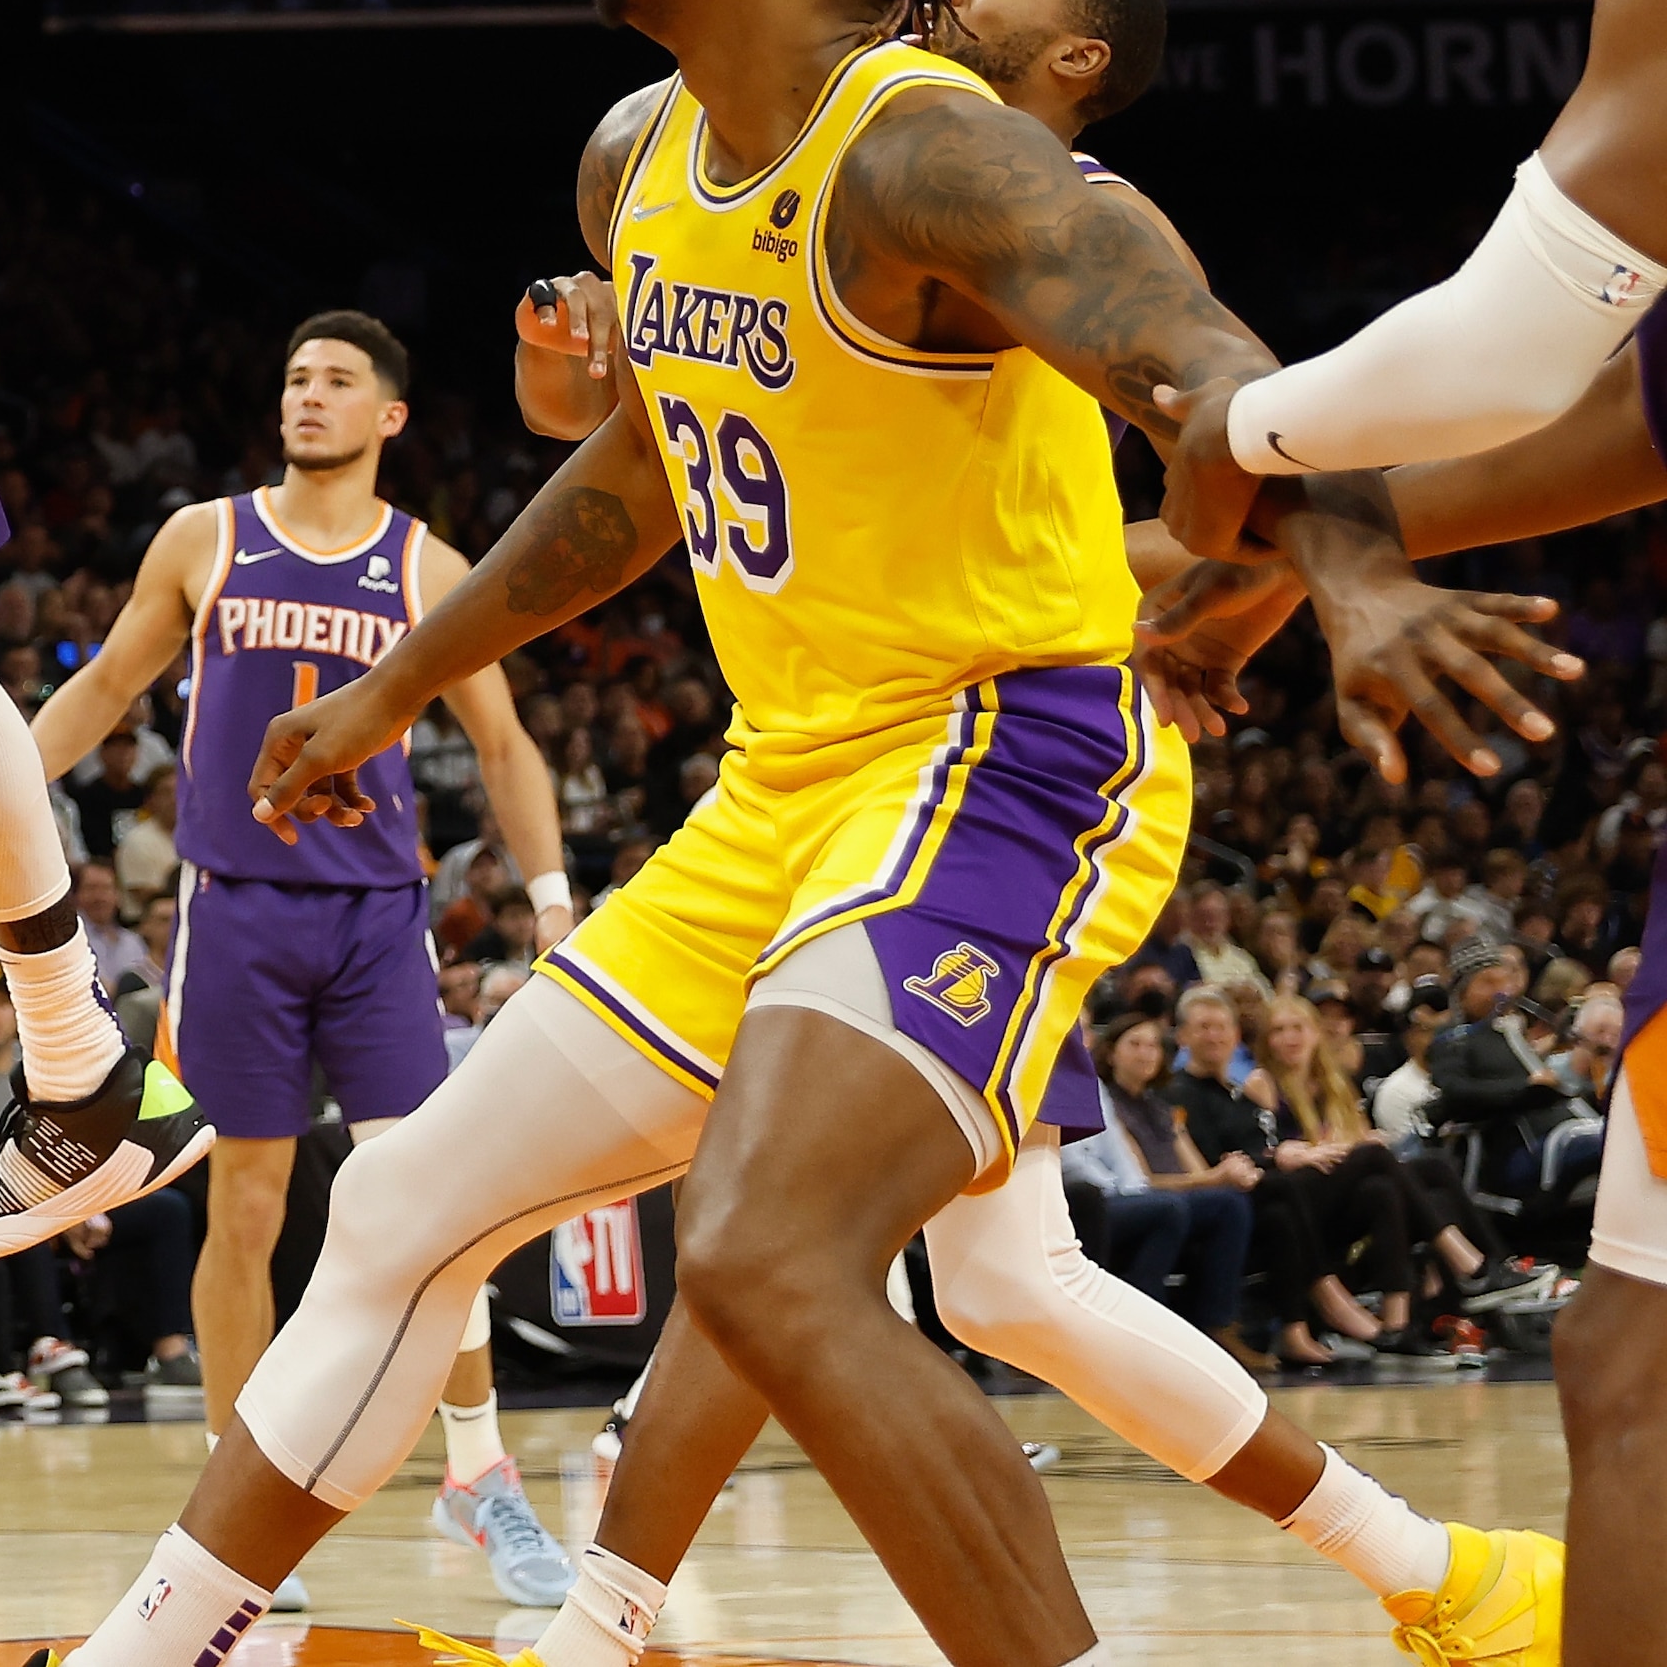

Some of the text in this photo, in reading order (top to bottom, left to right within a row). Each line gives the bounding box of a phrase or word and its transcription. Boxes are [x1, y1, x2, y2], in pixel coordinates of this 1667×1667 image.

[752, 227, 798, 263] bibigo
[623, 249, 798, 394] LAKERS
[653, 389, 796, 595] 39
[216, 596, 410, 670] PHOENIX
